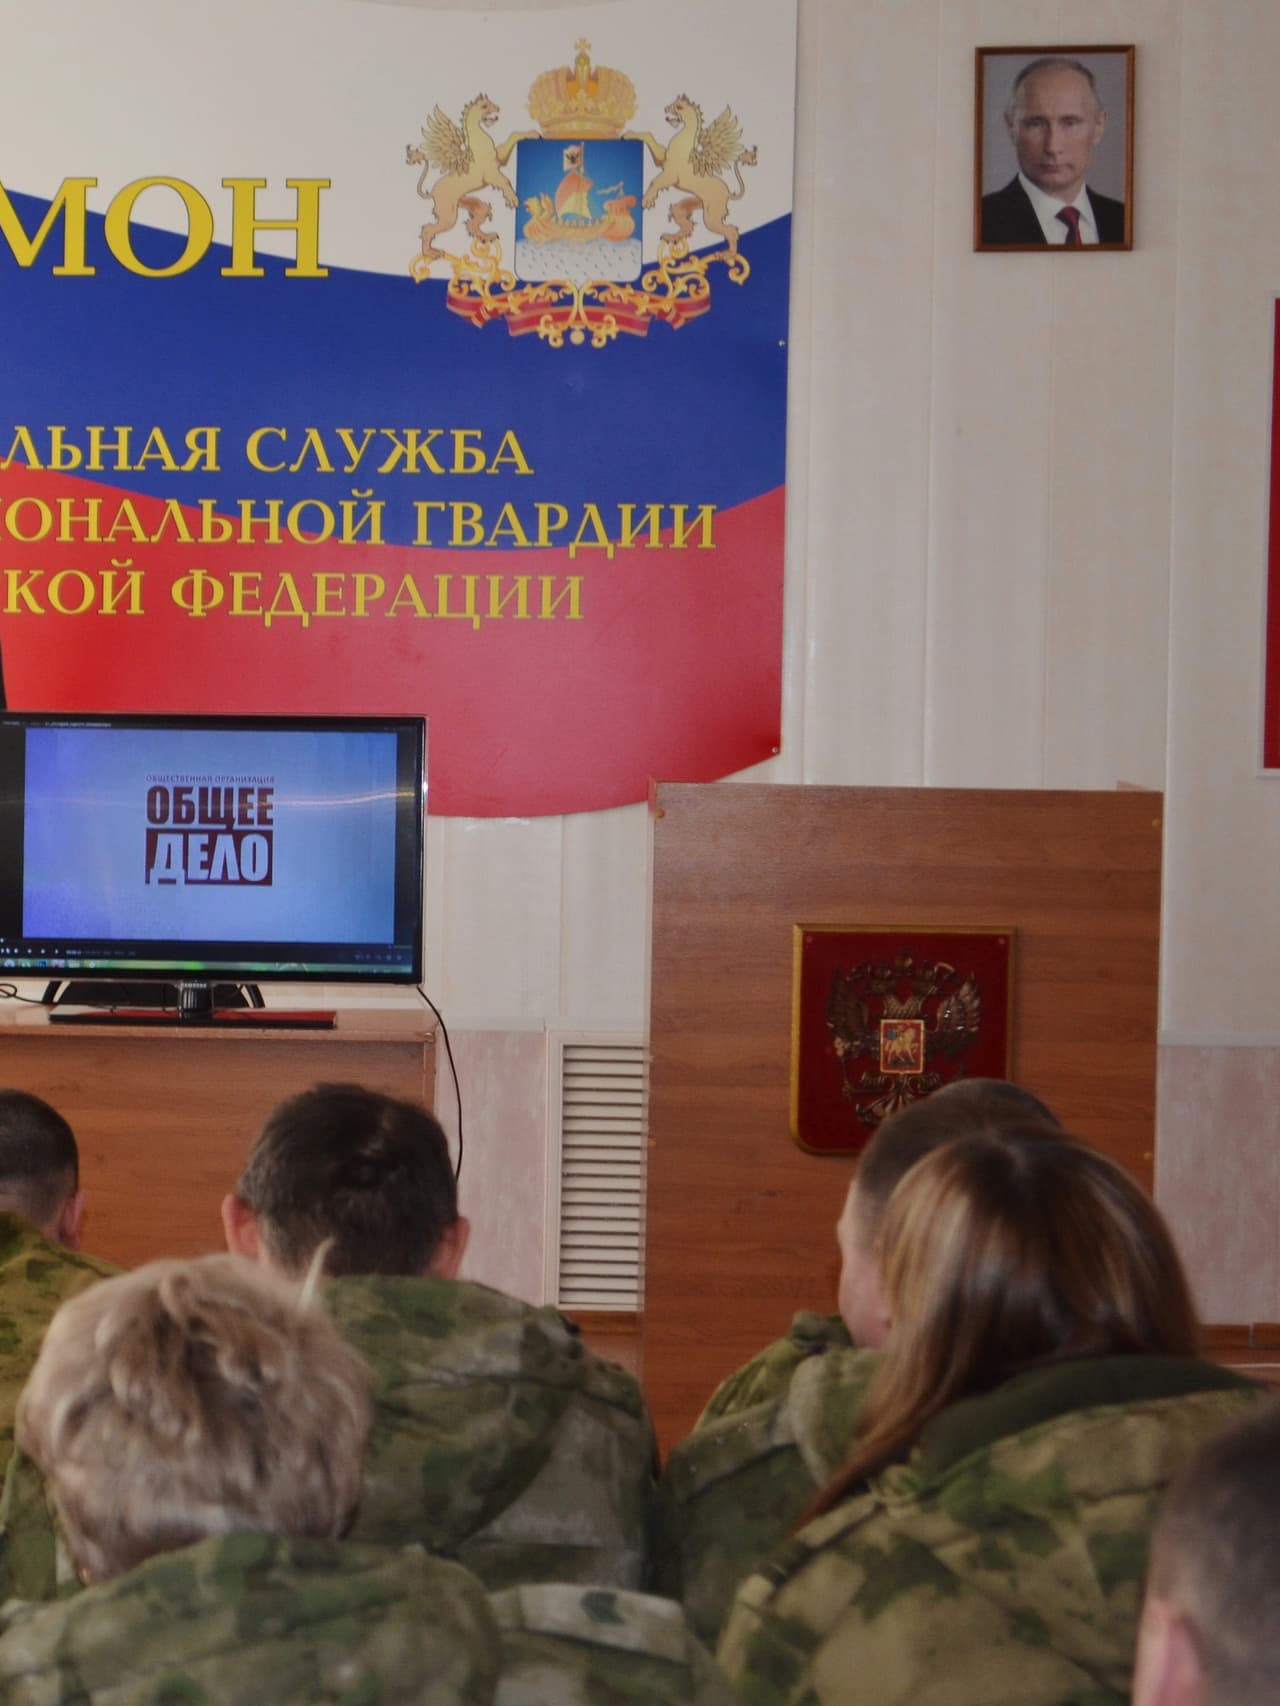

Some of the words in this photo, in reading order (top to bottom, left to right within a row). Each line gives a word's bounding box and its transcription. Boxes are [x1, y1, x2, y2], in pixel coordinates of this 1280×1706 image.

[245, 426, 535, 476] СЛУЖБА
[412, 501, 717, 560] ГВАРДИИ
[170, 568, 585, 630] ФЕДЕРАЦИИ
[146, 785, 274, 829] ОБЩЕЕ
[148, 832, 270, 886] ДЕЛО
